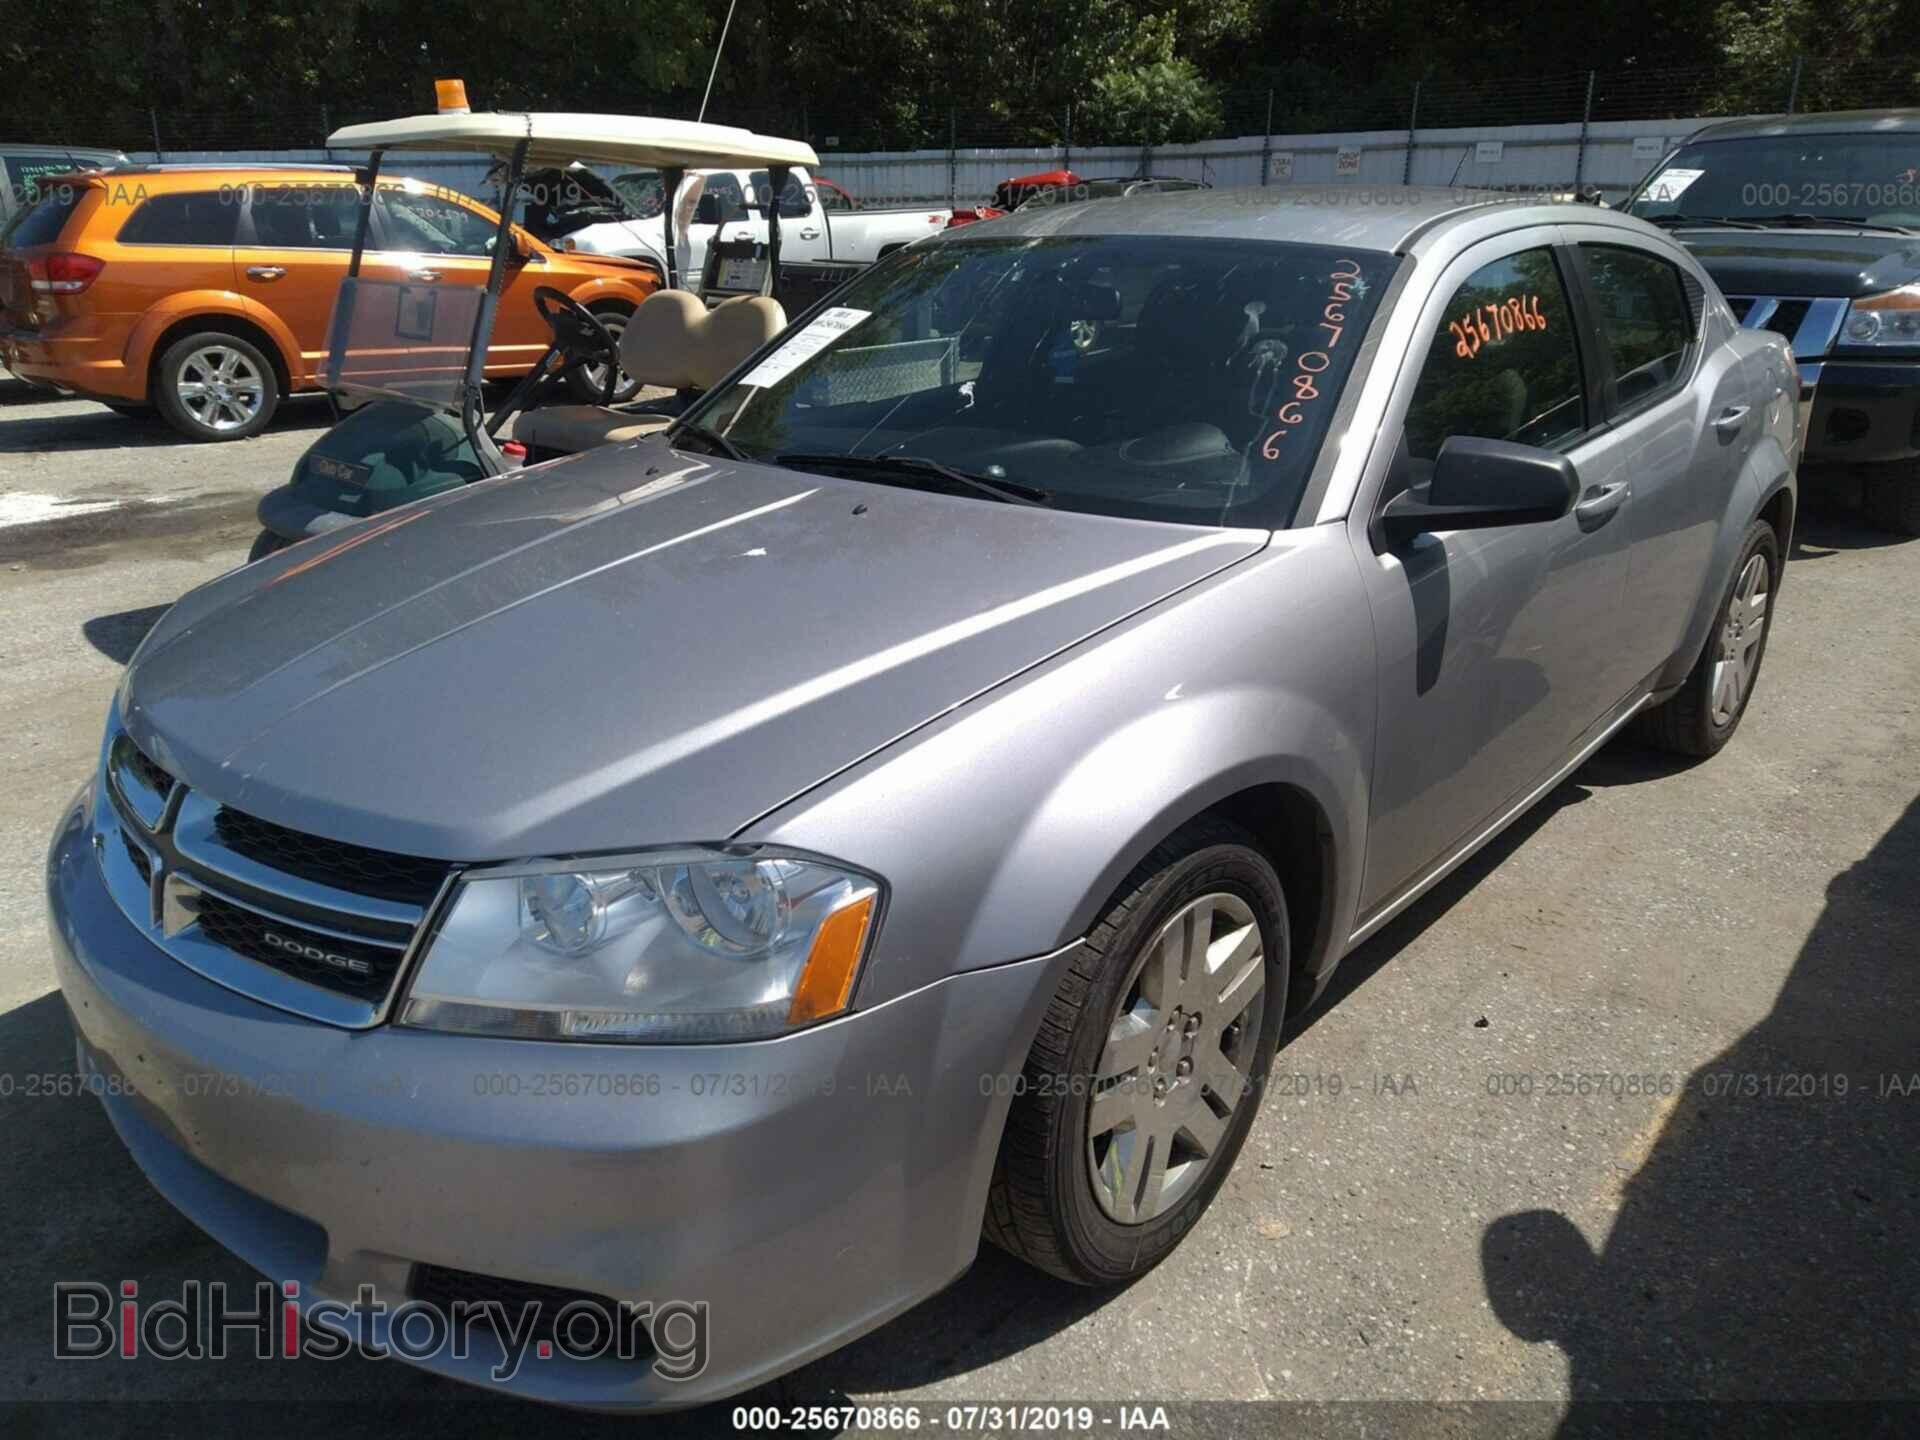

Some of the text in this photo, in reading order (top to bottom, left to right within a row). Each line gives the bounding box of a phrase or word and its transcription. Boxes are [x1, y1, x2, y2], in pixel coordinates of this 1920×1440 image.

[1449, 294, 1547, 359] 25670866
[1263, 259, 1361, 460] 25670866
[264, 932, 369, 973] DODGE
